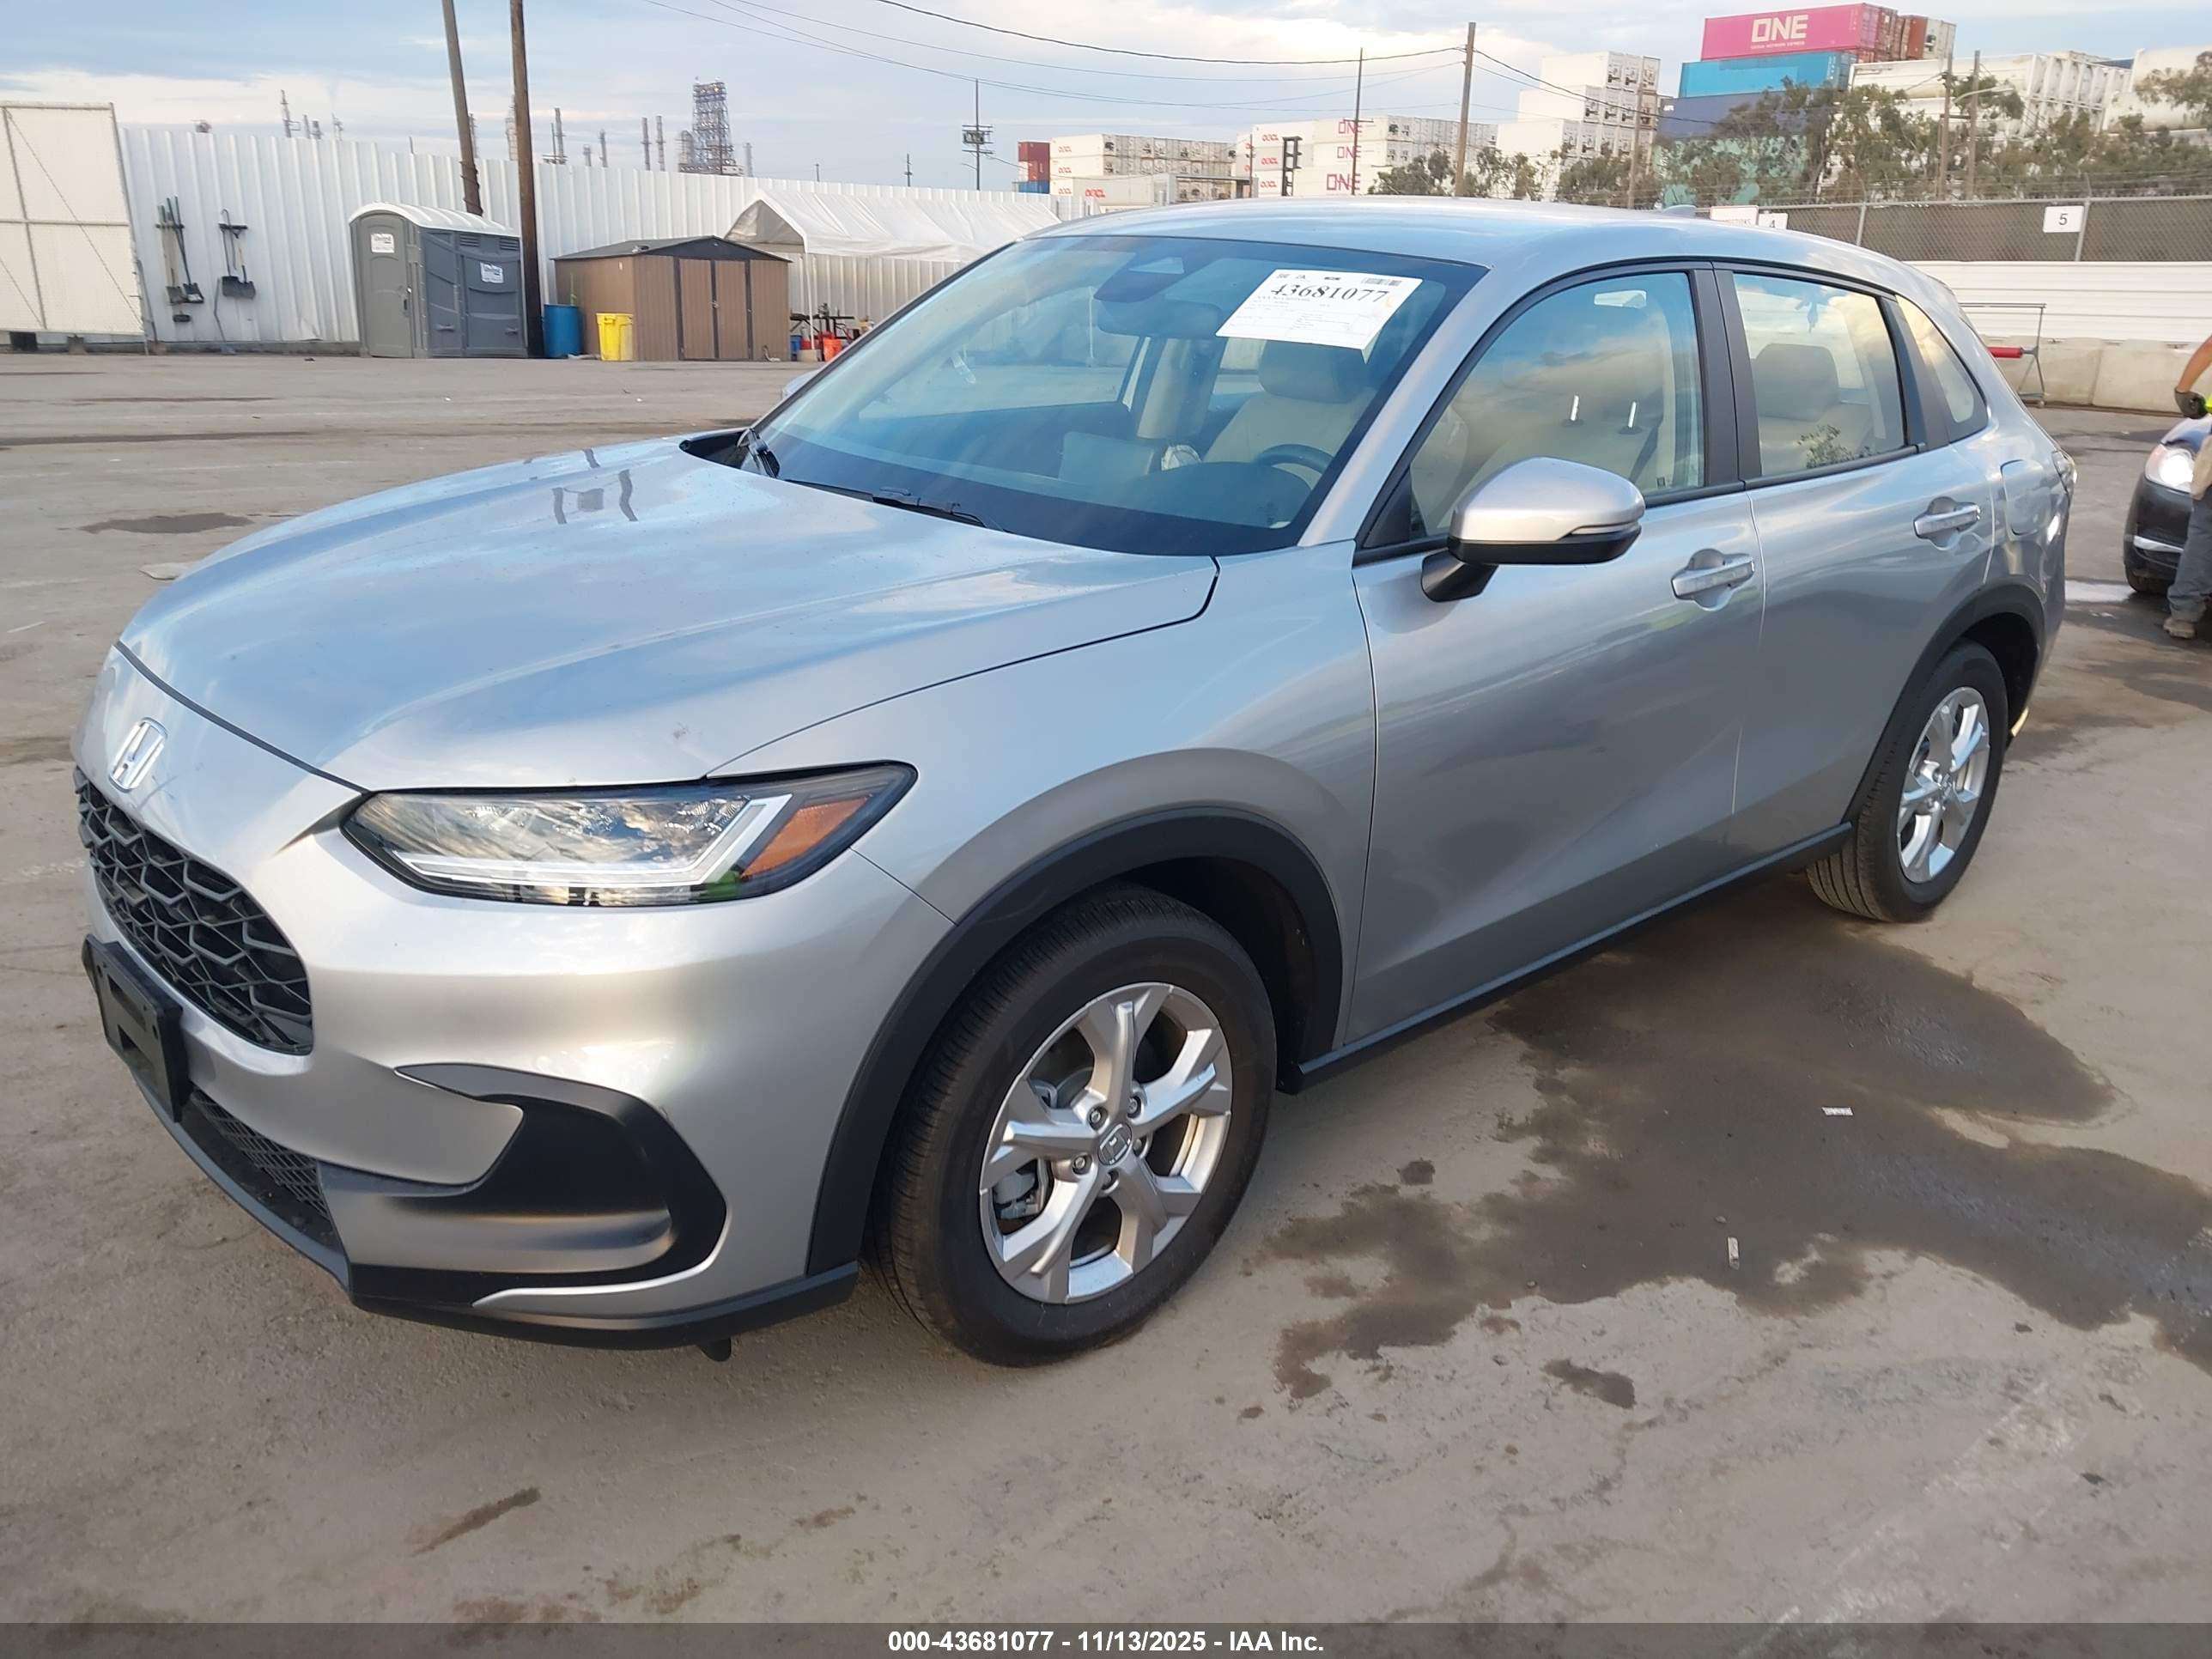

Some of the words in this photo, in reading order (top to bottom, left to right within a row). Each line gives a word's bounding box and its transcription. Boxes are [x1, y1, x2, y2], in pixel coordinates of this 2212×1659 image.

[1752, 15, 1808, 42] ONE
[1336, 146, 1361, 158] ONE
[1327, 173, 1360, 190] ONE
[2059, 213, 2068, 225] 5
[1271, 283, 1389, 302] 43681077
